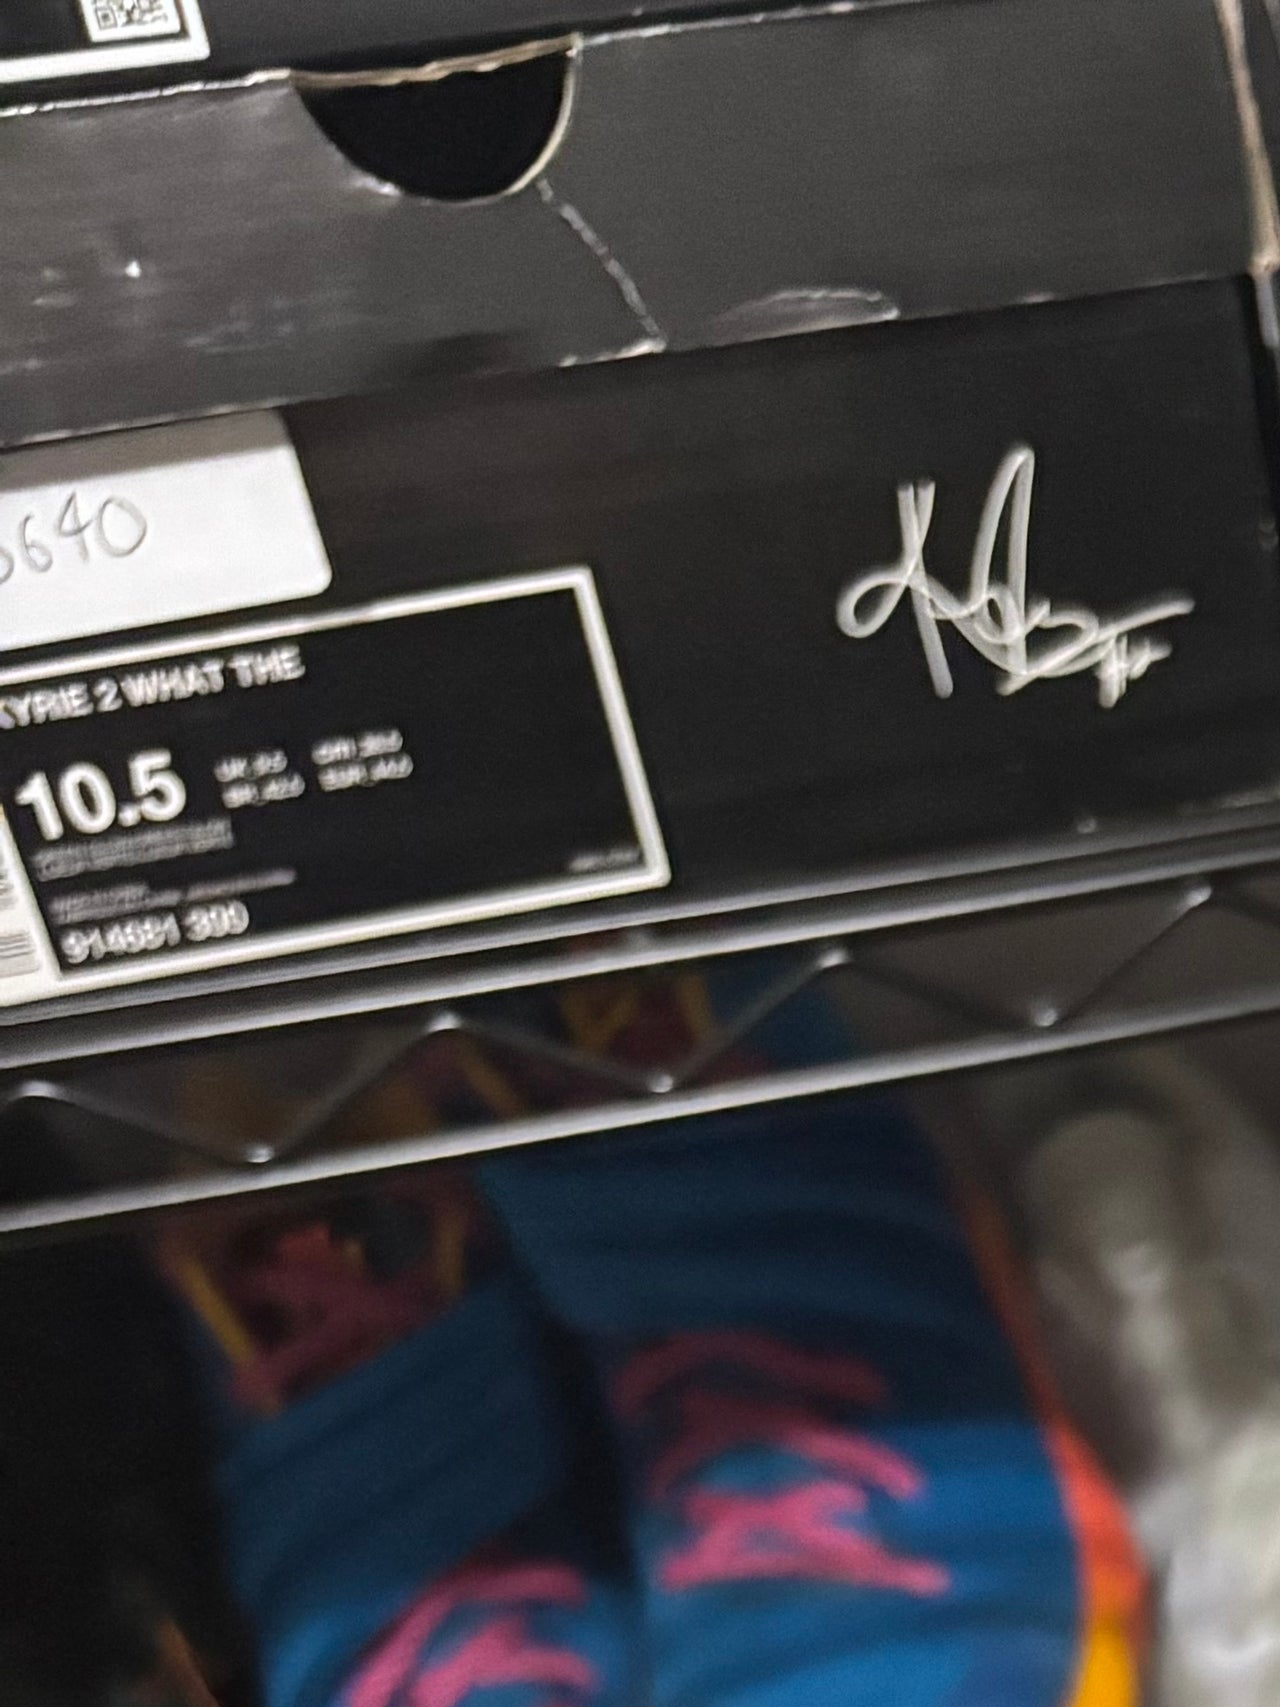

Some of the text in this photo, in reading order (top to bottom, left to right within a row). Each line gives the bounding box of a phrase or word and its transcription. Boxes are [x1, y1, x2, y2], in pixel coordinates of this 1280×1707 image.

[93, 675, 122, 713] 2
[119, 658, 225, 708] WHAT
[227, 643, 306, 689] THE
[15, 747, 187, 841] 10.5
